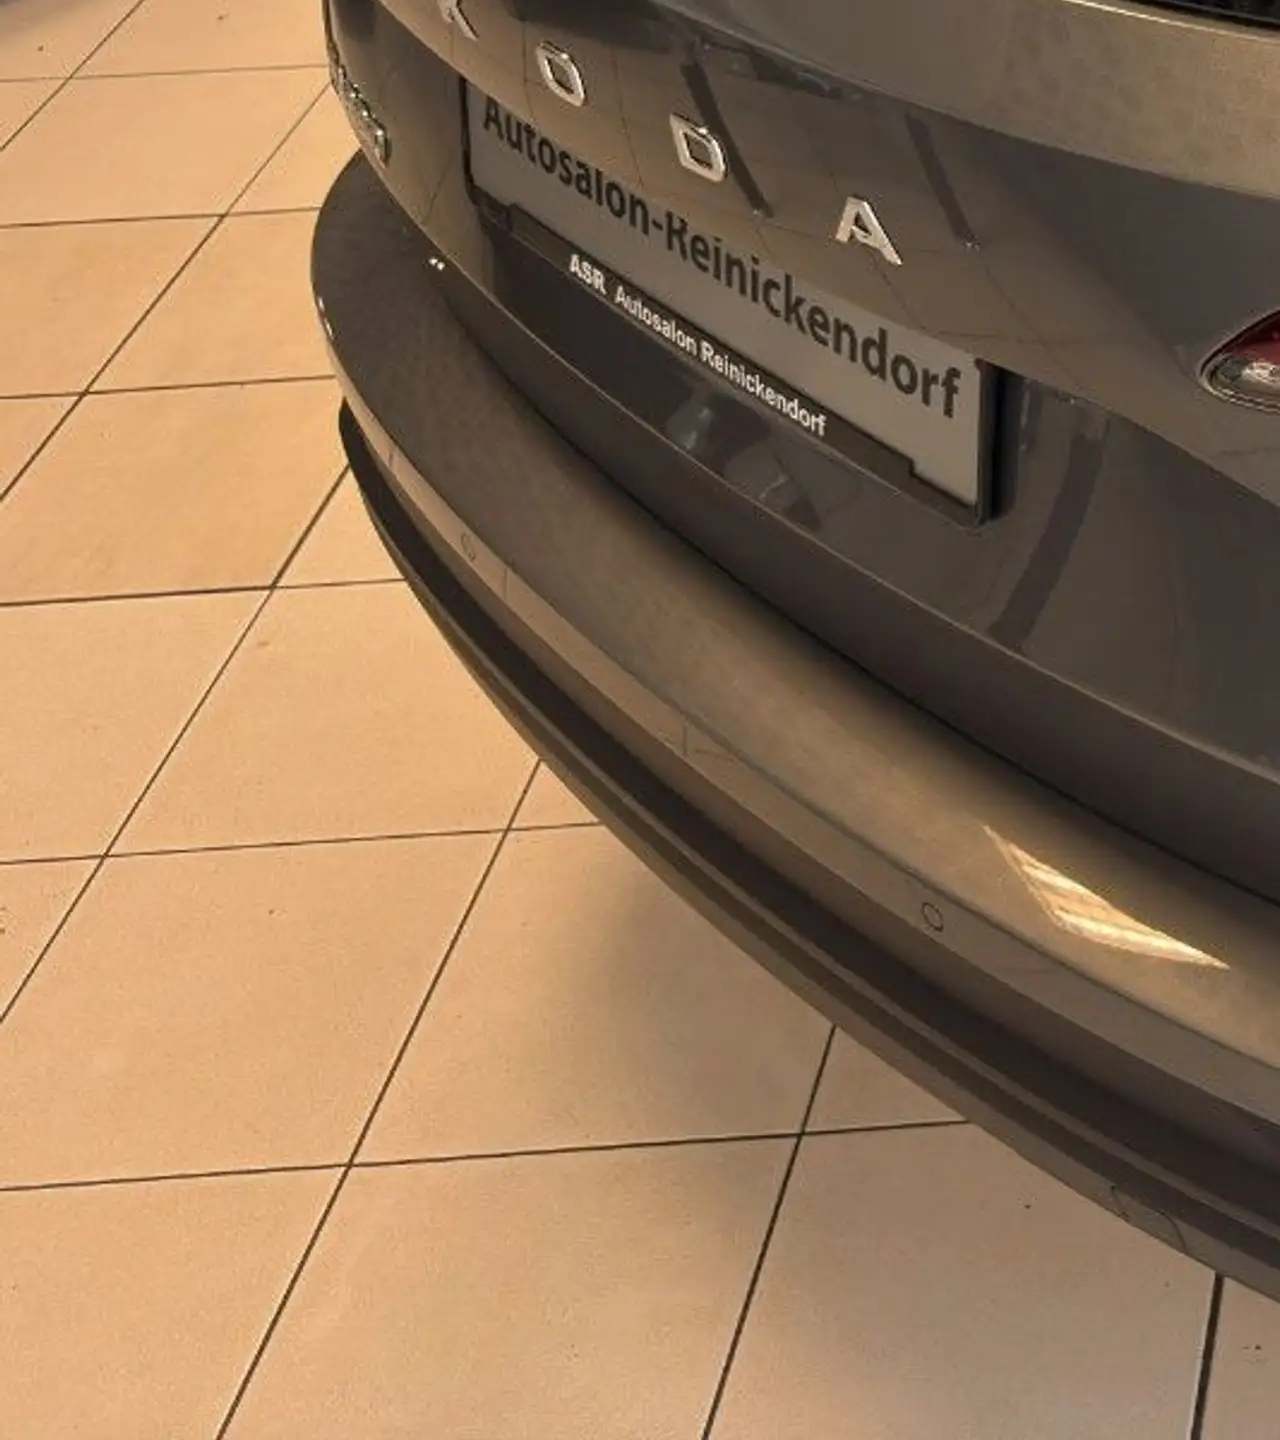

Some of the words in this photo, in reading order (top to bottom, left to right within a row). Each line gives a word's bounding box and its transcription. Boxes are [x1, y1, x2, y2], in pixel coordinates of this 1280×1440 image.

[484, 95, 961, 418] Autosalon-Reinickendorf
[569, 254, 606, 295] ASR
[614, 285, 697, 357] Autosalon
[700, 340, 827, 436] Reinickendorf
